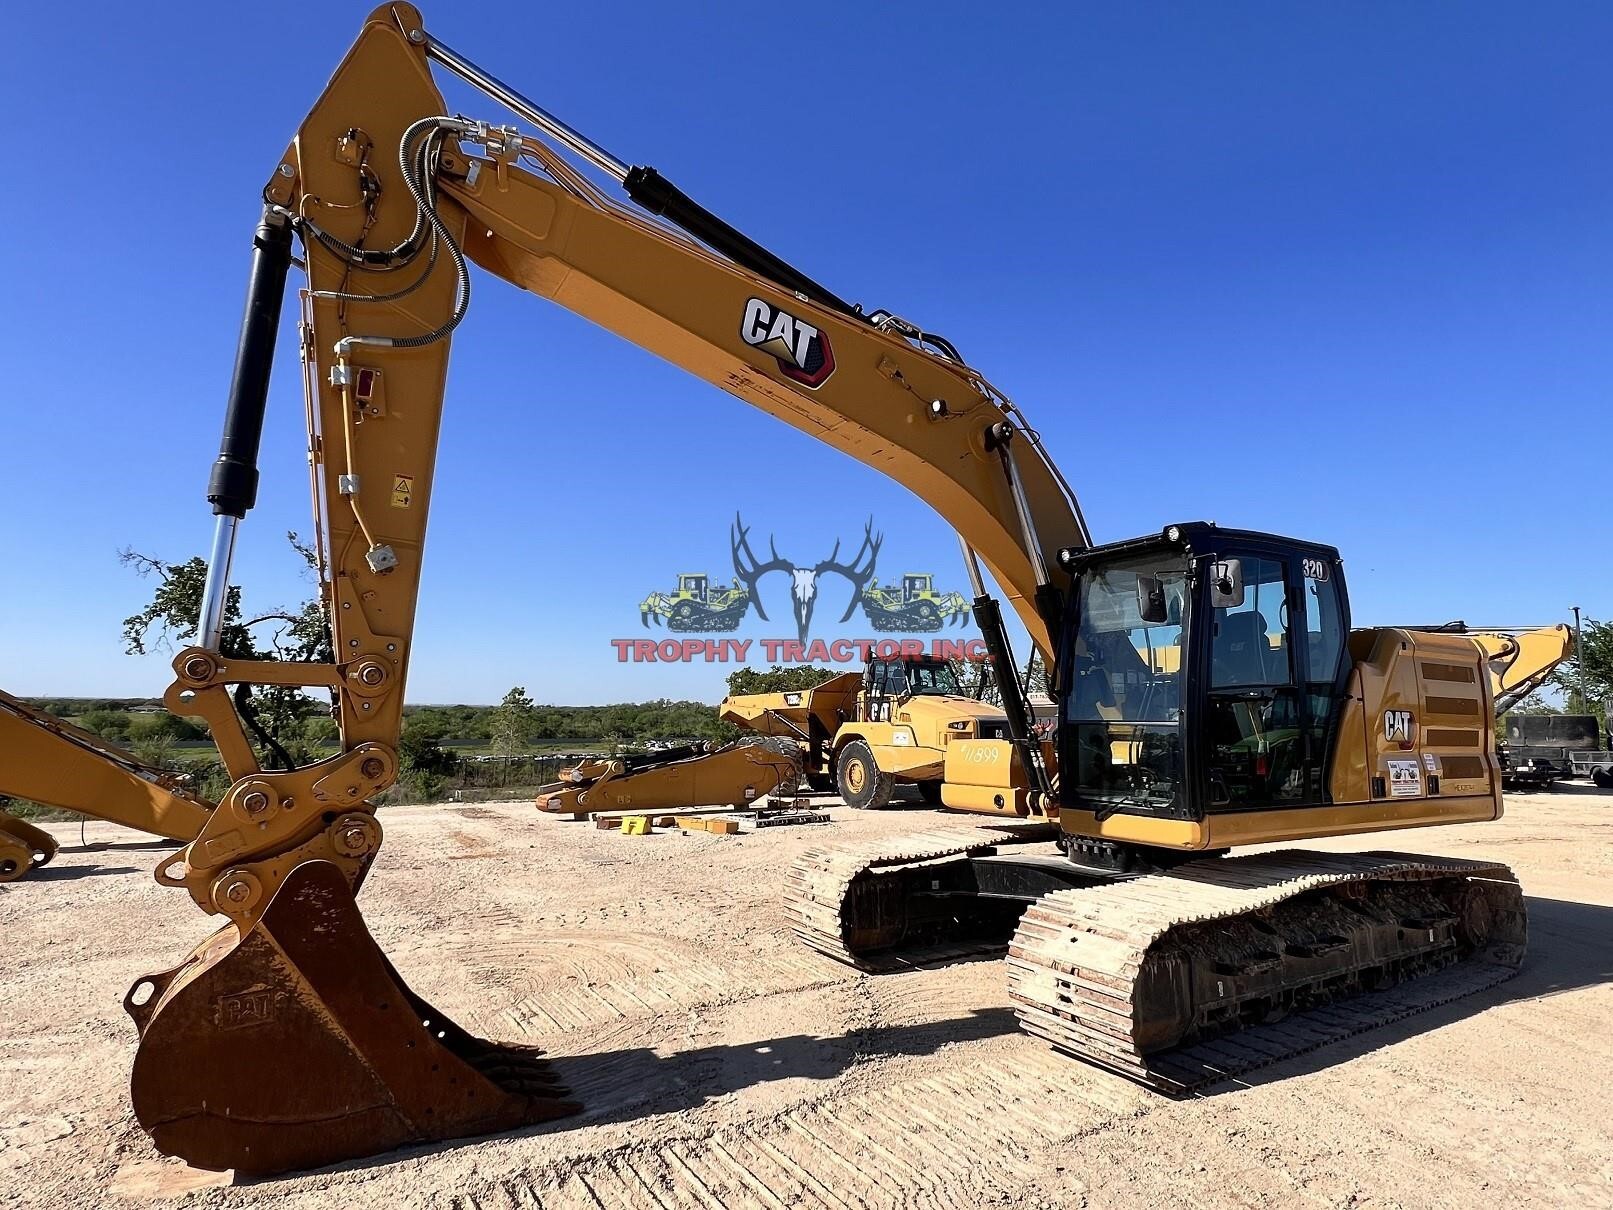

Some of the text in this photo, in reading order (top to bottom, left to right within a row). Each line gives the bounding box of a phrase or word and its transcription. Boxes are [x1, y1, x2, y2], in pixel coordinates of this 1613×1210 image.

[742, 298, 818, 369] CAT
[1302, 558, 1323, 579] 320
[1385, 711, 1410, 741] CAT
